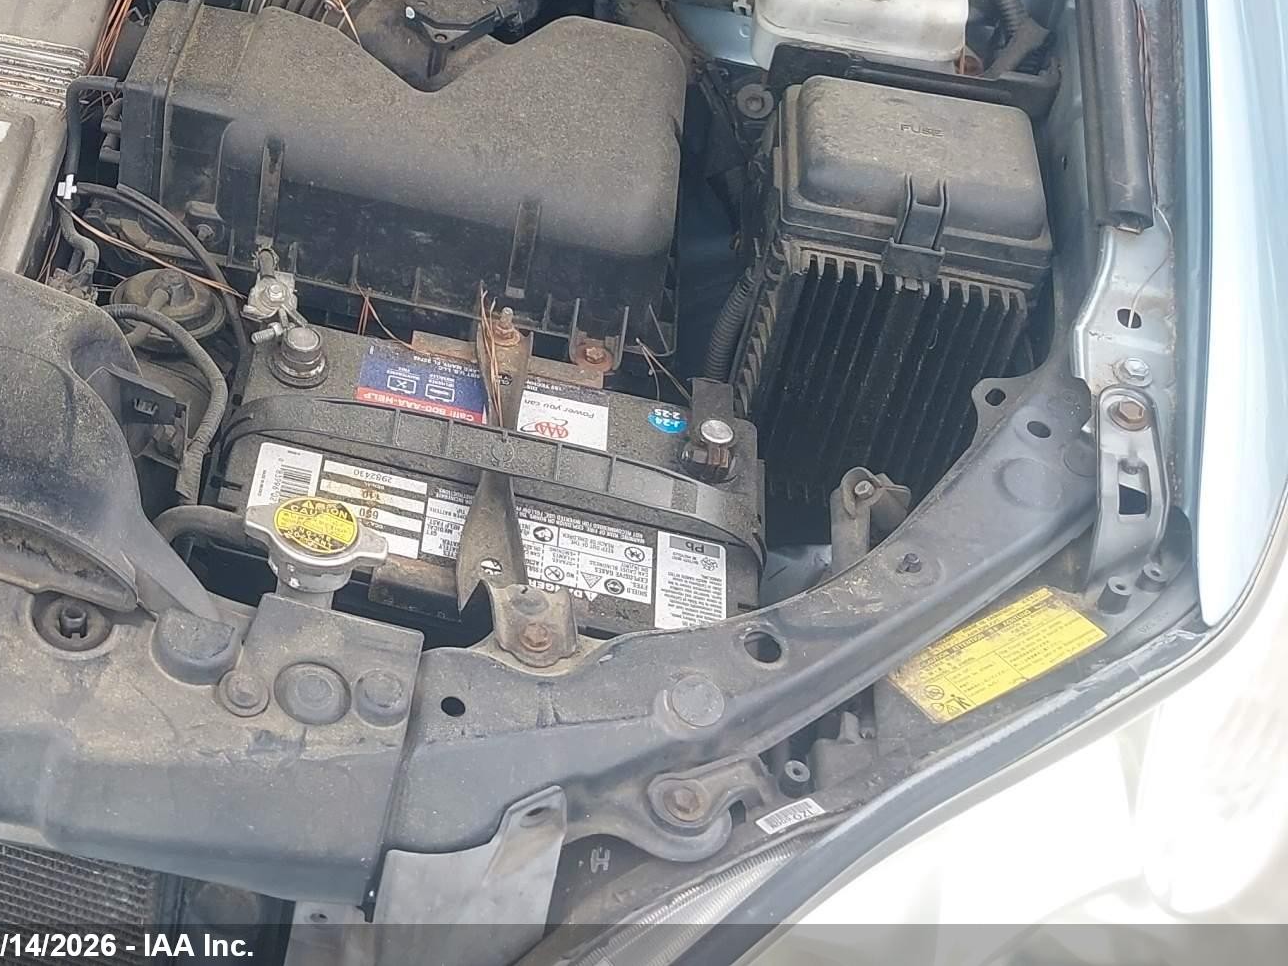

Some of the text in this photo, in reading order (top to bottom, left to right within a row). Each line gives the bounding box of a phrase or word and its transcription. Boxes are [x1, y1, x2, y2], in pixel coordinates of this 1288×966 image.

[543, 403, 562, 411] you
[562, 407, 595, 419] Power
[538, 423, 566, 438] AAA
[685, 541, 705, 554] Pb
[626, 587, 648, 597] SHIELD
